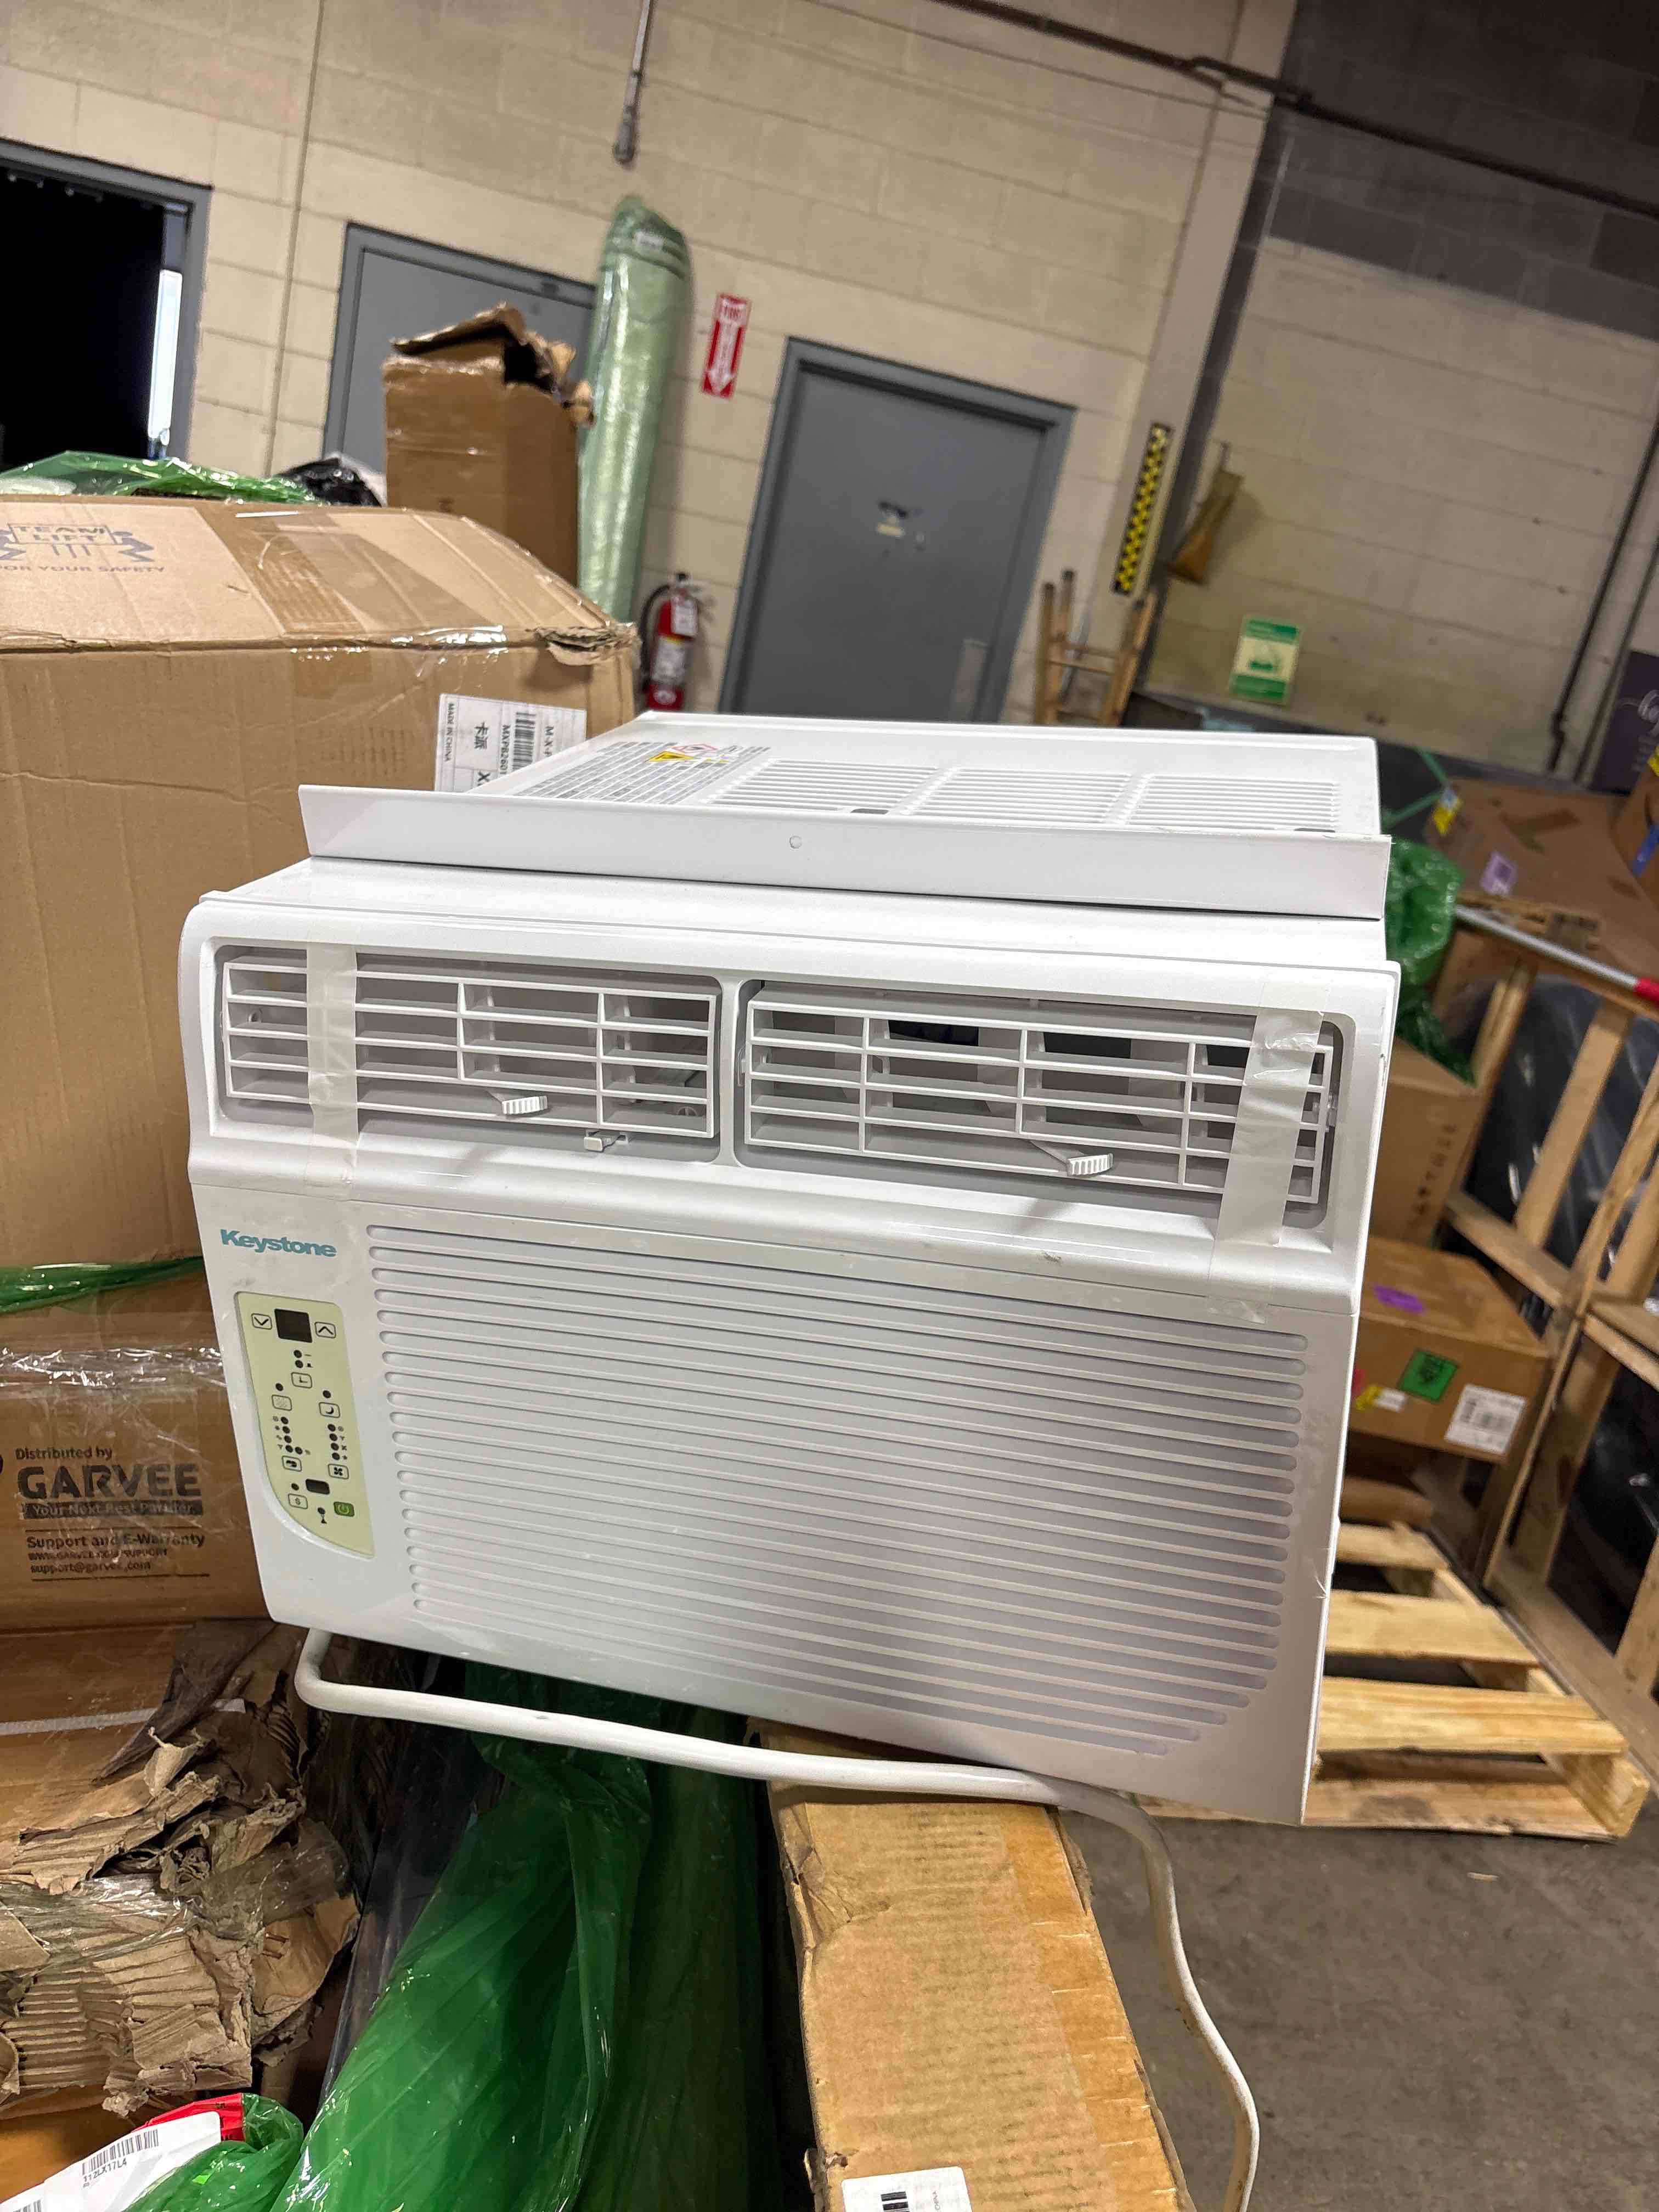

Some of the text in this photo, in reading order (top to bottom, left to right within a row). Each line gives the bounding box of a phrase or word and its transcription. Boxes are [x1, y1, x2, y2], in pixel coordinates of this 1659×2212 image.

[14, 526, 105, 534] TEAM
[446, 728, 453, 736] IN
[444, 737, 453, 762] CHINA
[220, 1228, 337, 1257] Keystone
[16, 1447, 112, 1460] Distributed by
[18, 1464, 202, 1500] GARVEE
[32, 1504, 64, 1516] Your
[68, 1503, 102, 1515] Next
[27, 1536, 87, 1549] Support
[91, 1534, 117, 1546] and
